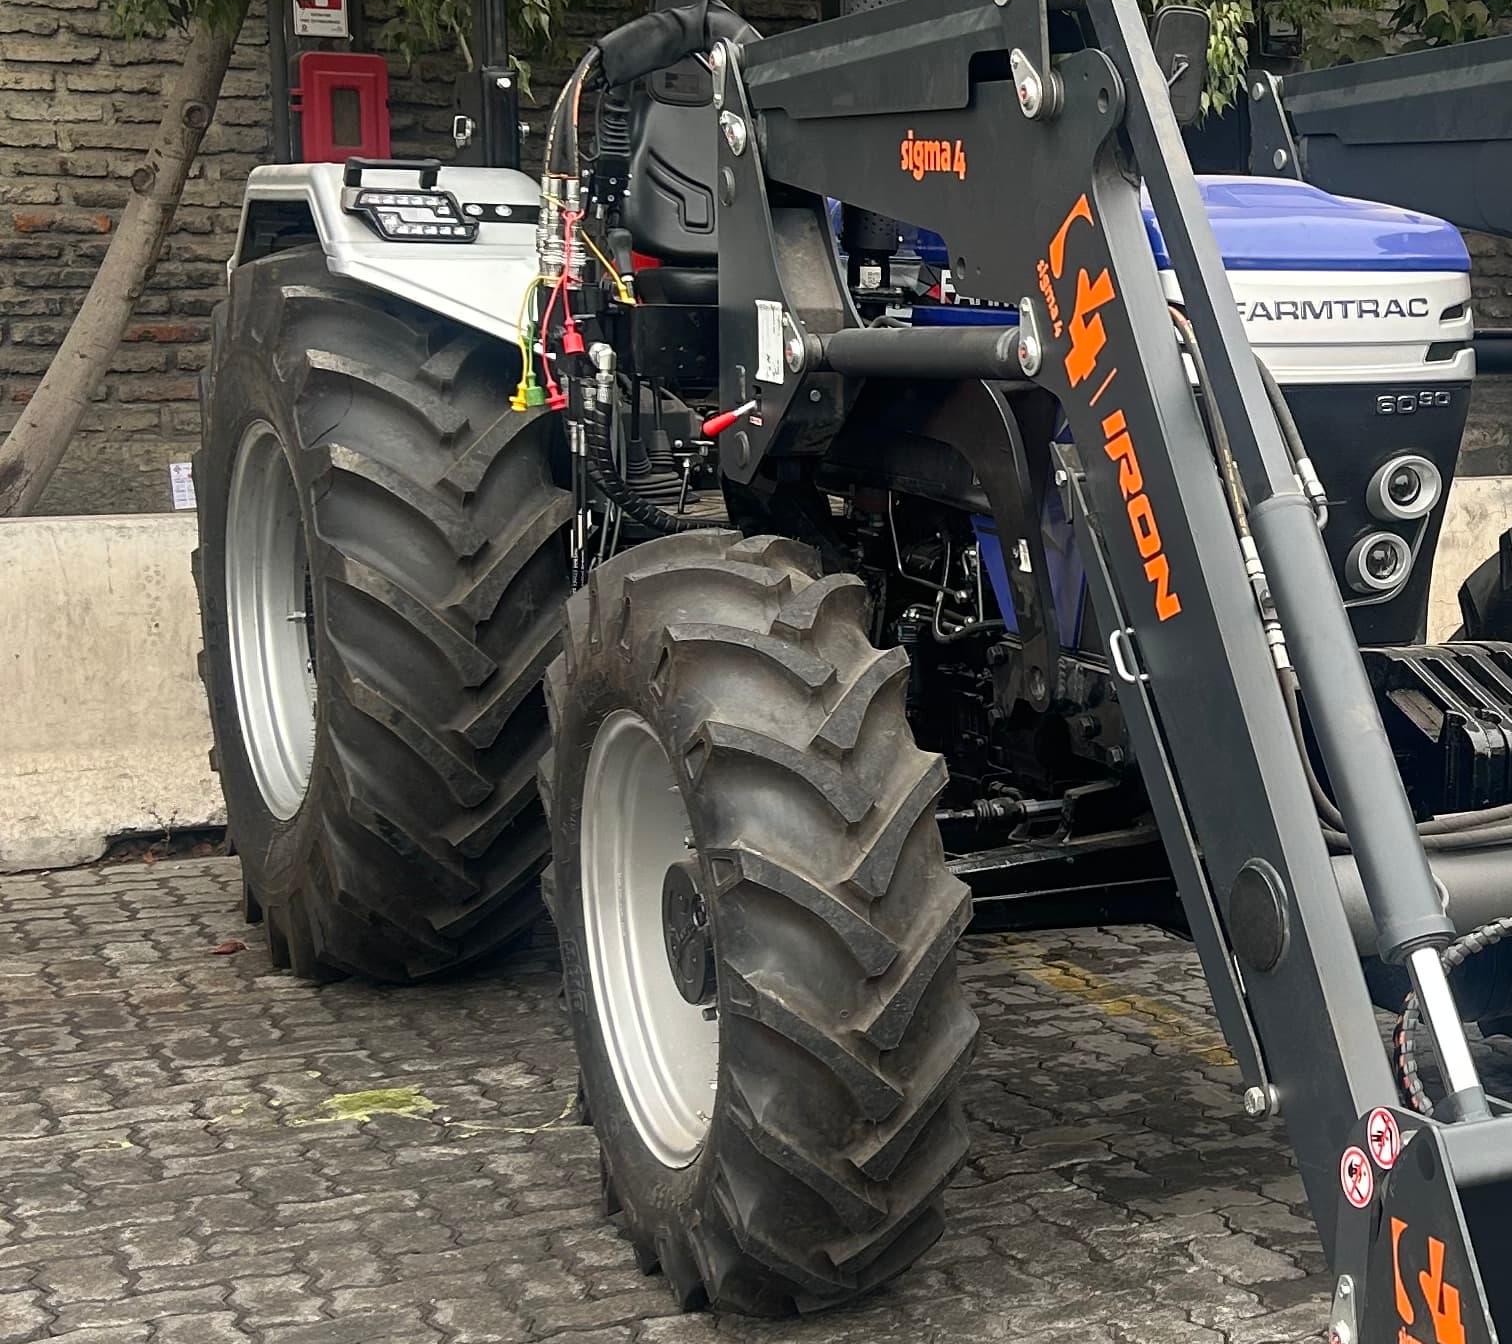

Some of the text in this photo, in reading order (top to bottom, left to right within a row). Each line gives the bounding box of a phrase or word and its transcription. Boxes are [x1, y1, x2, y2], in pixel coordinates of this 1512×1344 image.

[901, 129, 966, 181] sigma 4
[1037, 259, 1060, 321] sigma
[1102, 408, 1182, 623] IRON
